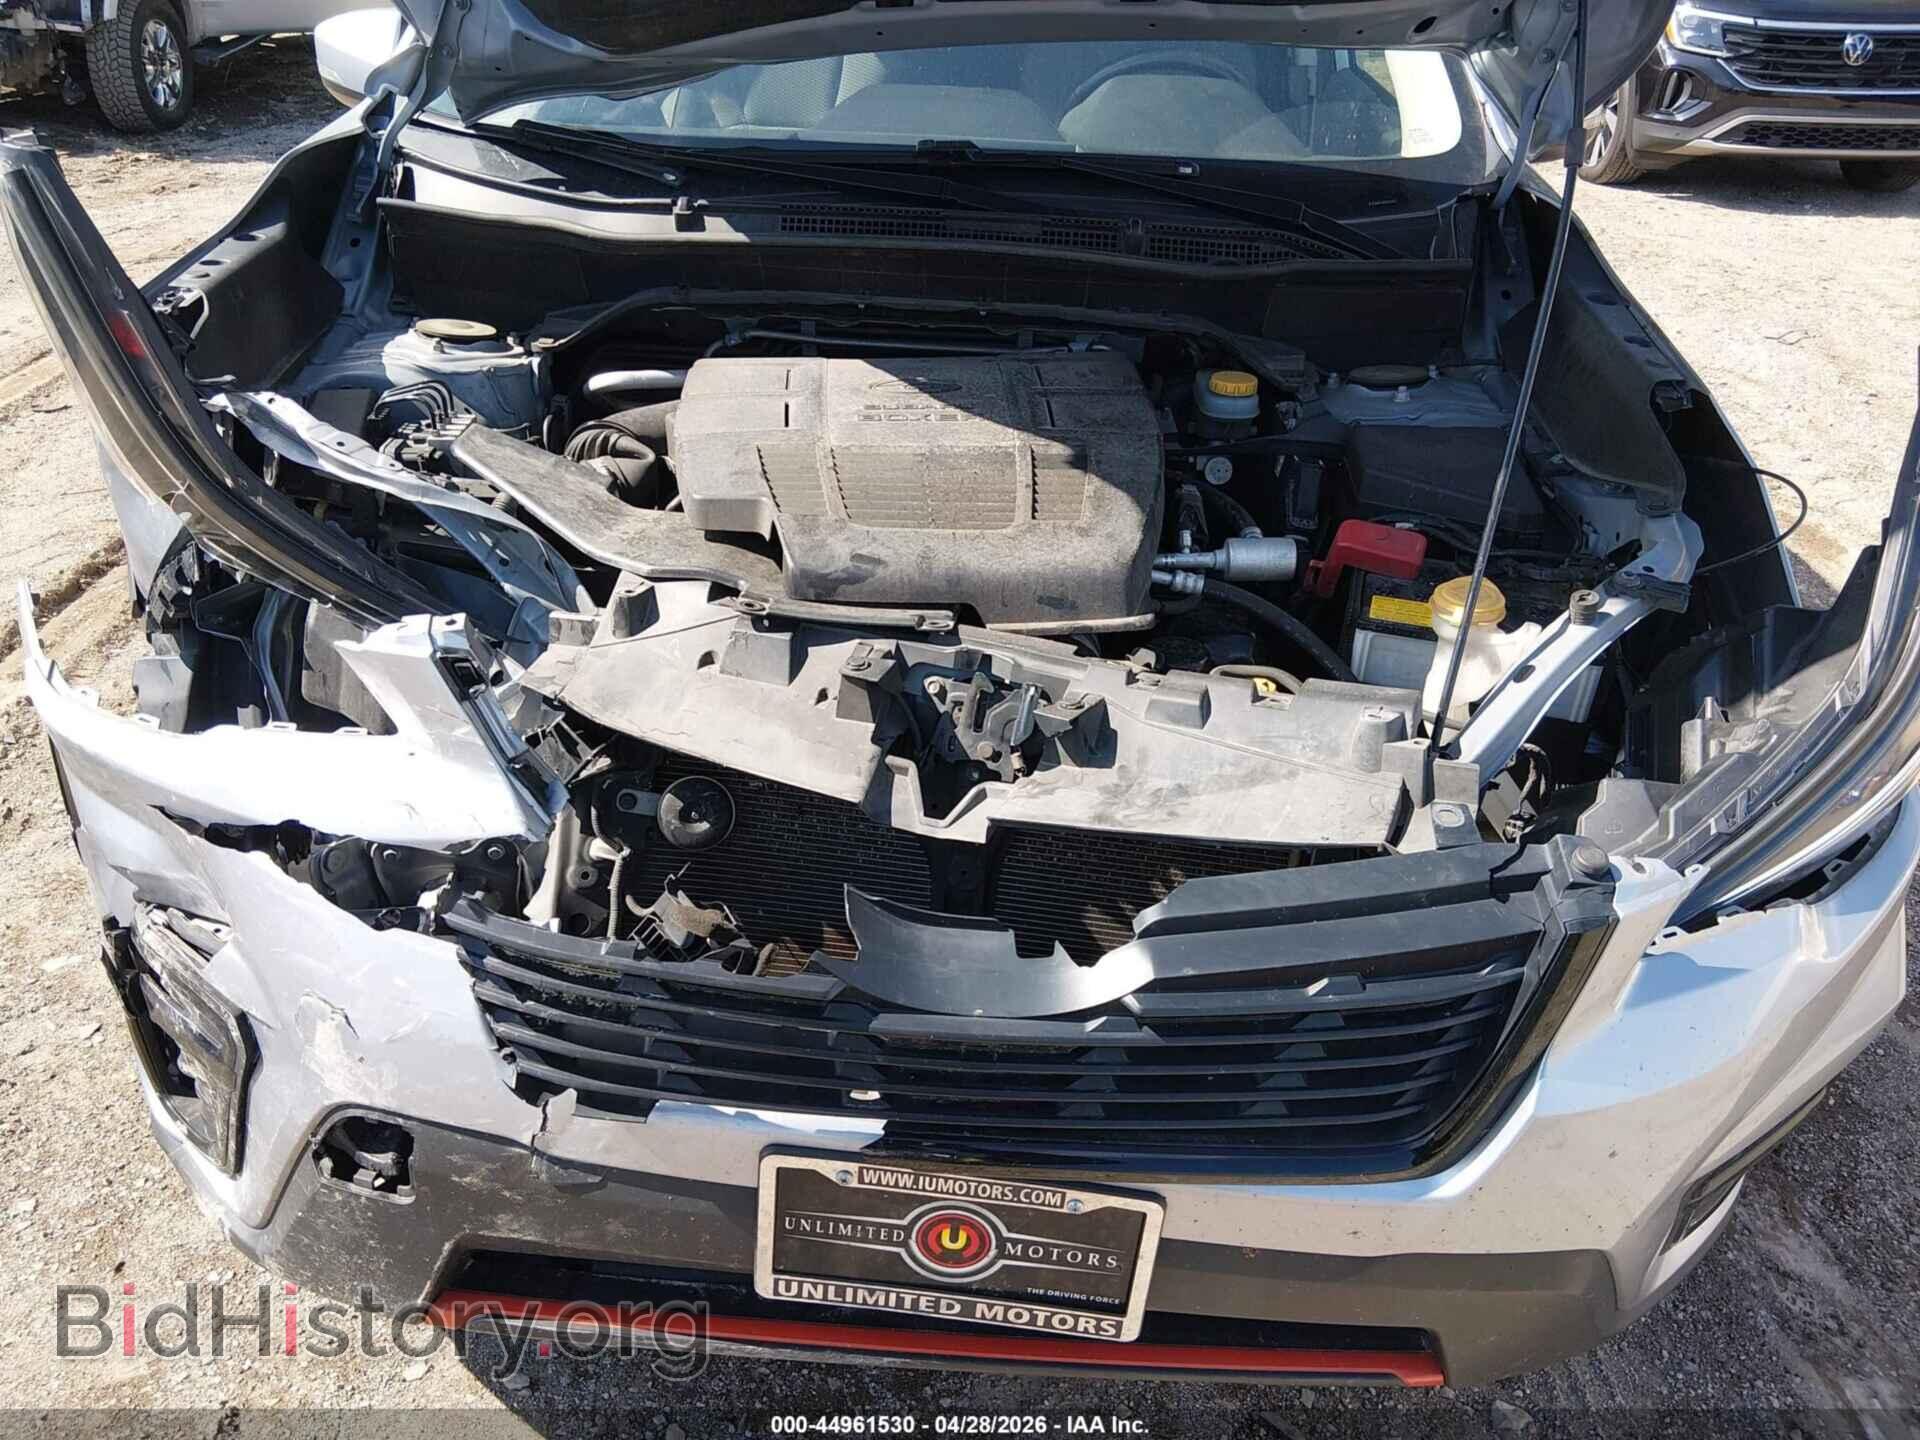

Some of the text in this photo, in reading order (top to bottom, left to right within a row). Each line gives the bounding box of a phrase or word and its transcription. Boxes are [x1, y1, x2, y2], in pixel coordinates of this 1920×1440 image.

[862, 1167, 1062, 1207] WWW.IUMOTORS.COM
[784, 1216, 905, 1242] UNLIMITED
[1004, 1241, 1118, 1269] MOTORS
[778, 1279, 1118, 1336] UNLIMITED MOTORS
[1026, 1287, 1121, 1304] THE DRIVING FORCE
